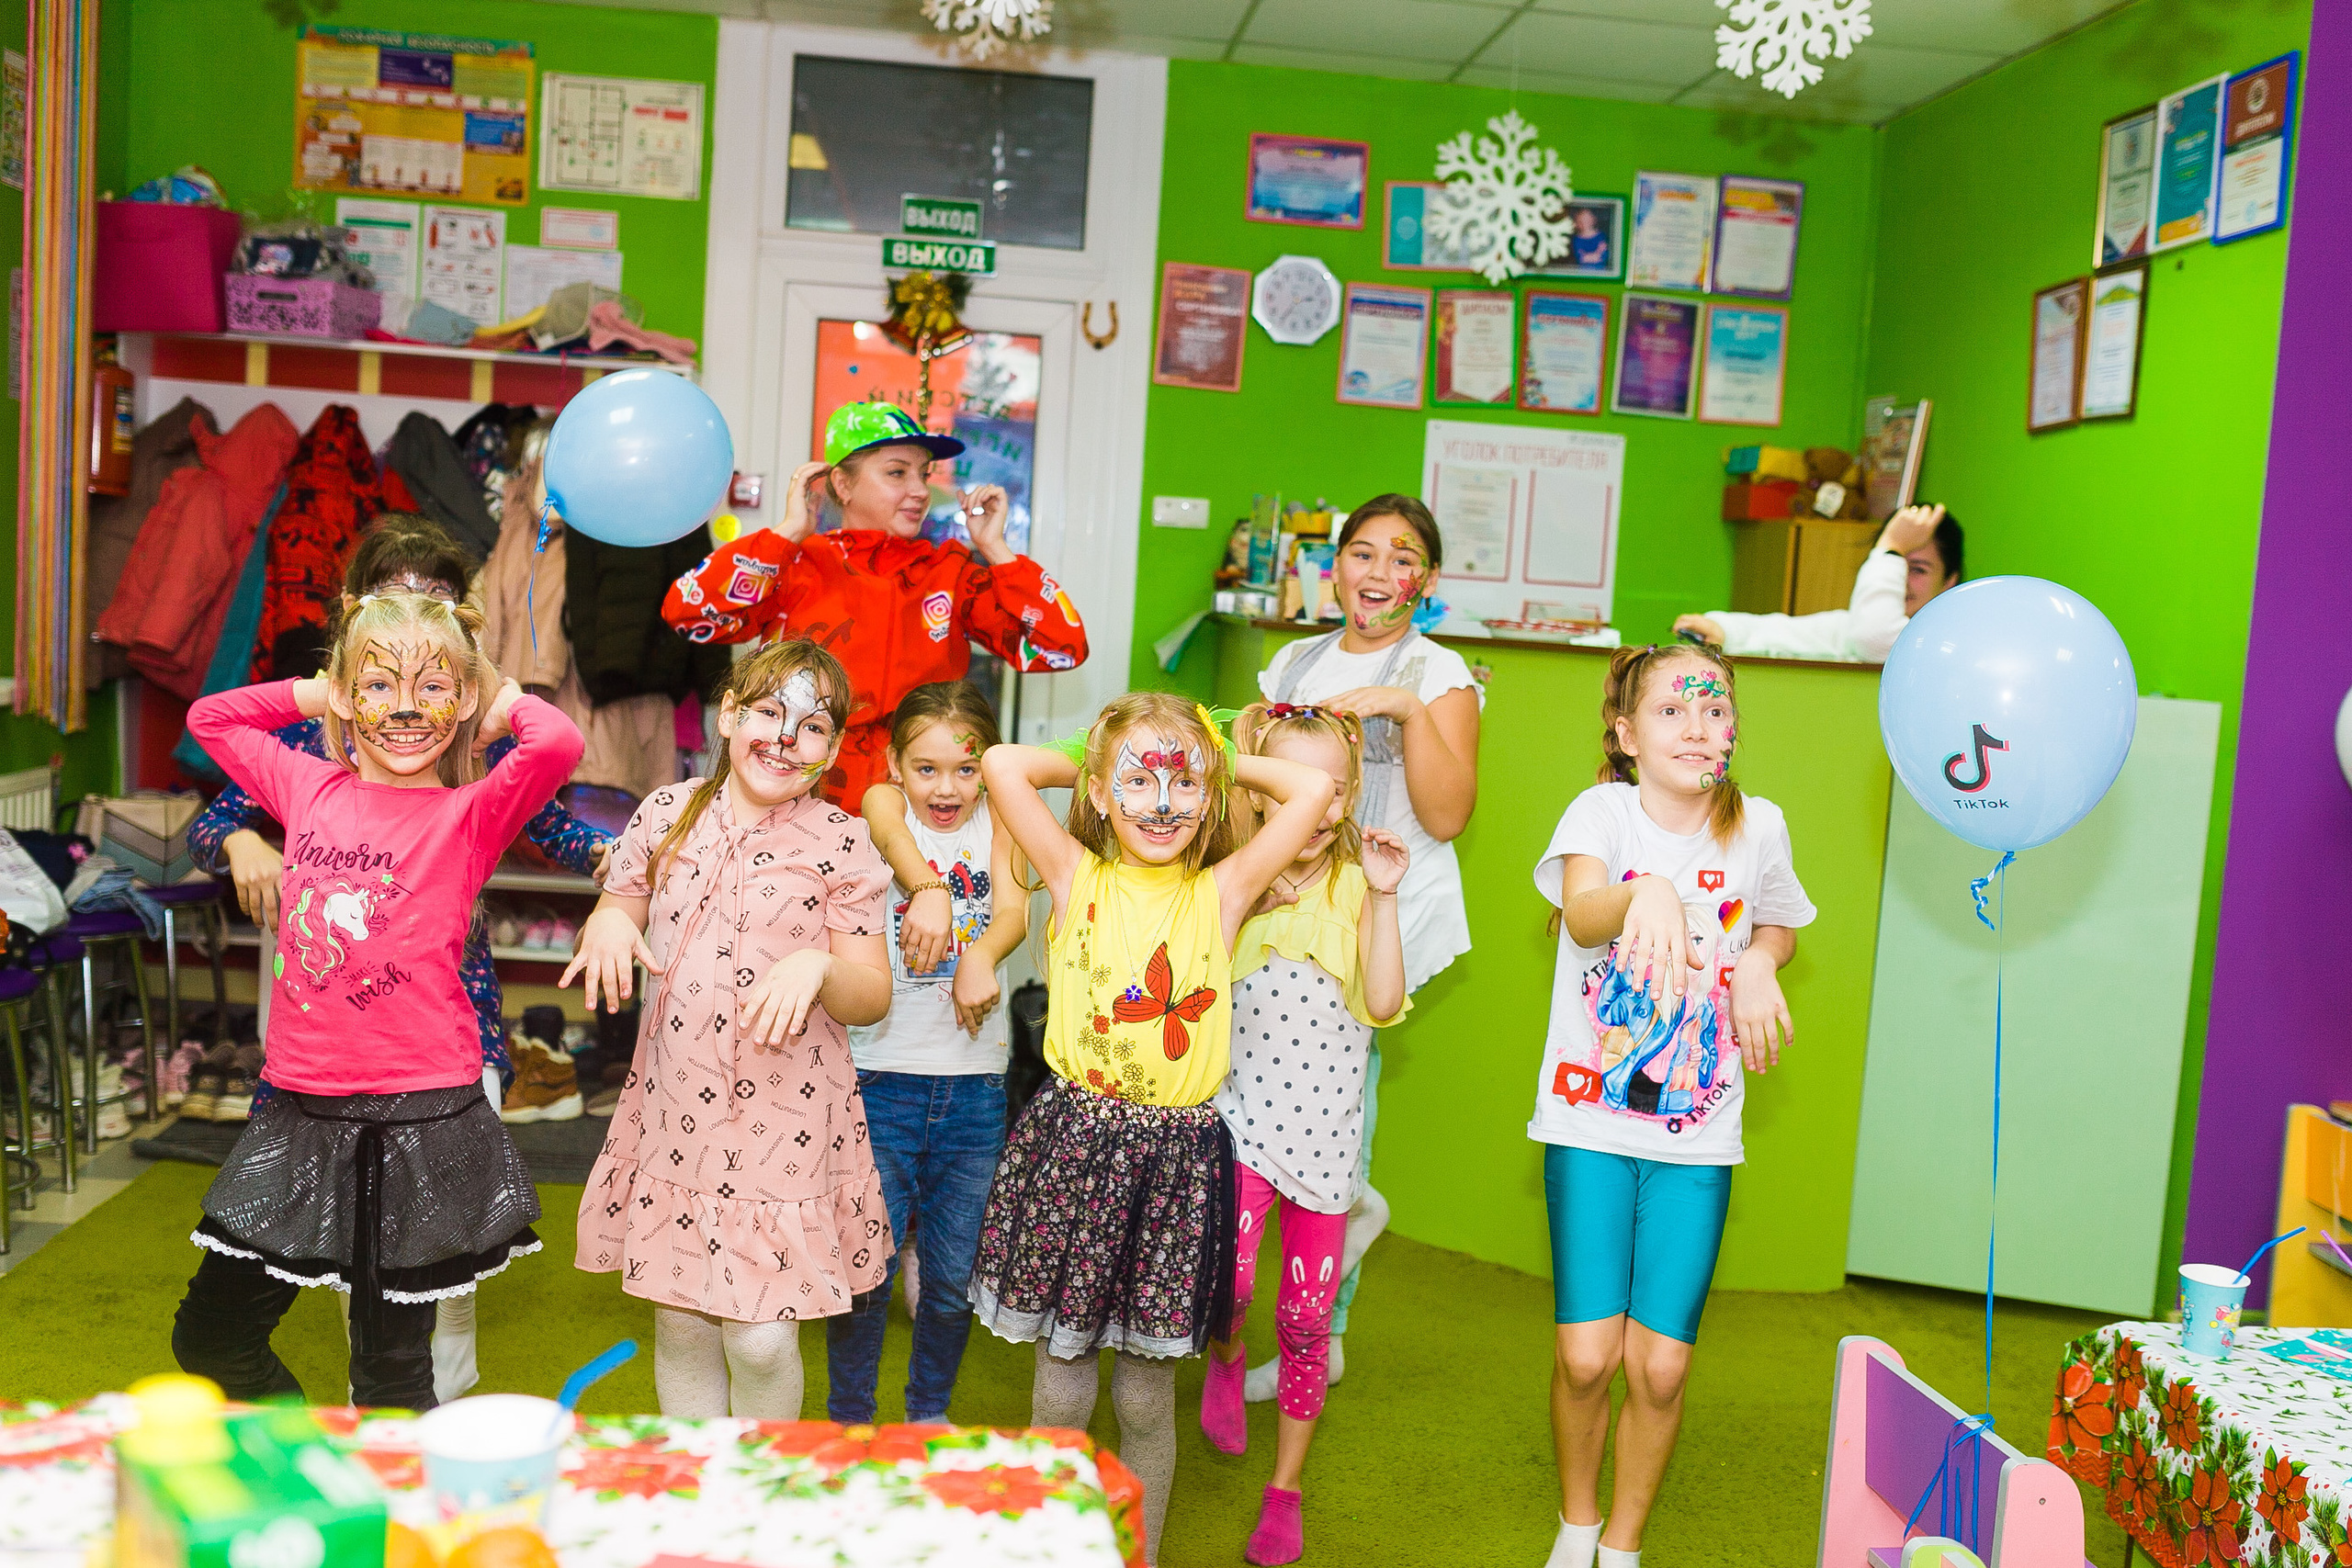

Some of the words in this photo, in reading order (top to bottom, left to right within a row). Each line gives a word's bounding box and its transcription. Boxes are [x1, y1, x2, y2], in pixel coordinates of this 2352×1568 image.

[906, 206, 977, 235] ВЫХОД
[892, 242, 986, 271] ВЫХОД
[1953, 798, 2010, 810] TikTok
[293, 830, 399, 872] Unicorn
[695, 905, 718, 941] LOUISVUITTON
[766, 895, 797, 928] LOUISVUITTON
[686, 1055, 725, 1080] LOUISVUITTON
[770, 1100, 808, 1119] LOUISVUITTON
[758, 1132, 786, 1168] LOUISVUITTON
[639, 1213, 673, 1244] LOUISVUITTON
[727, 1246, 760, 1268] LOUISVUITTON
